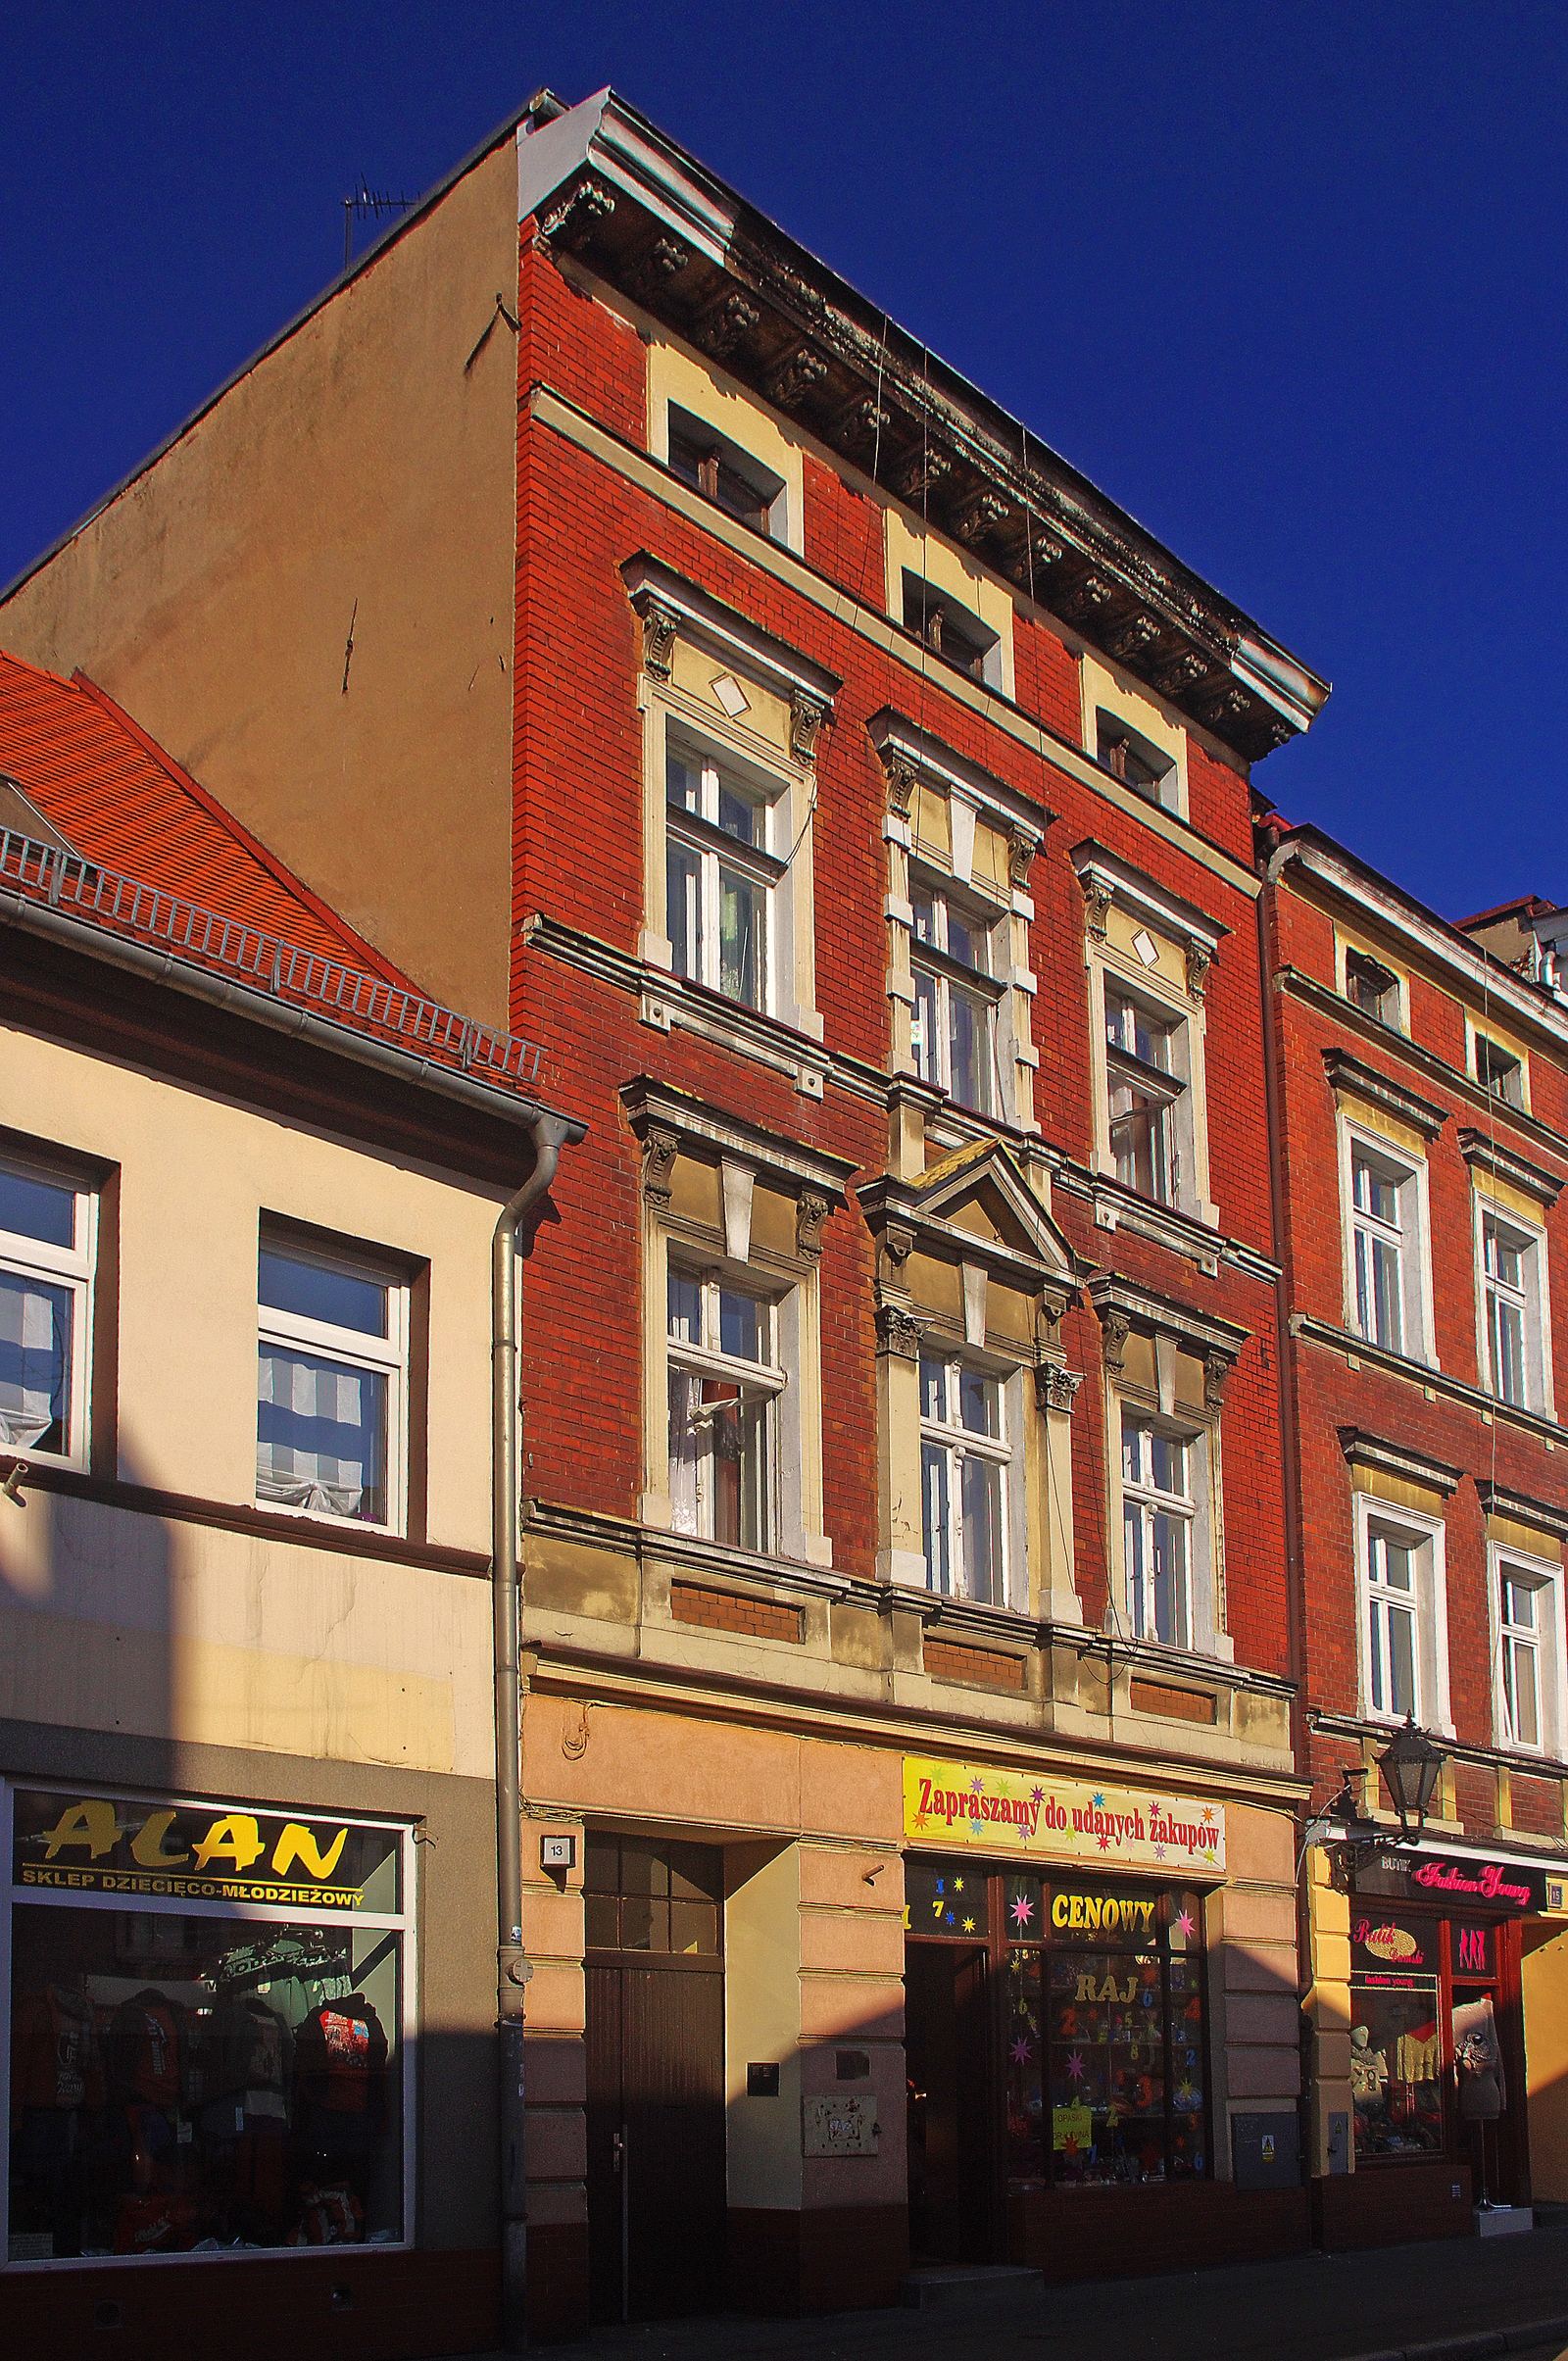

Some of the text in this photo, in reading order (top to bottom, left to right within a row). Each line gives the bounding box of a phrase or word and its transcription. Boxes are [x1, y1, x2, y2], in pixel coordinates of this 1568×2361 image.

[919, 1778, 1220, 1855] Zapraszamy do udanych zakupów
[43, 1800, 348, 1879] ALAN
[551, 1845, 563, 1856] 13
[22, 1869, 365, 1906] SKLEP DZIECIĘCO-MŁODZIEŻOWY
[1478, 1864, 1531, 1906] Young
[1052, 1894, 1155, 1934] CENOWY
[1074, 1975, 1138, 2004] RAJ
